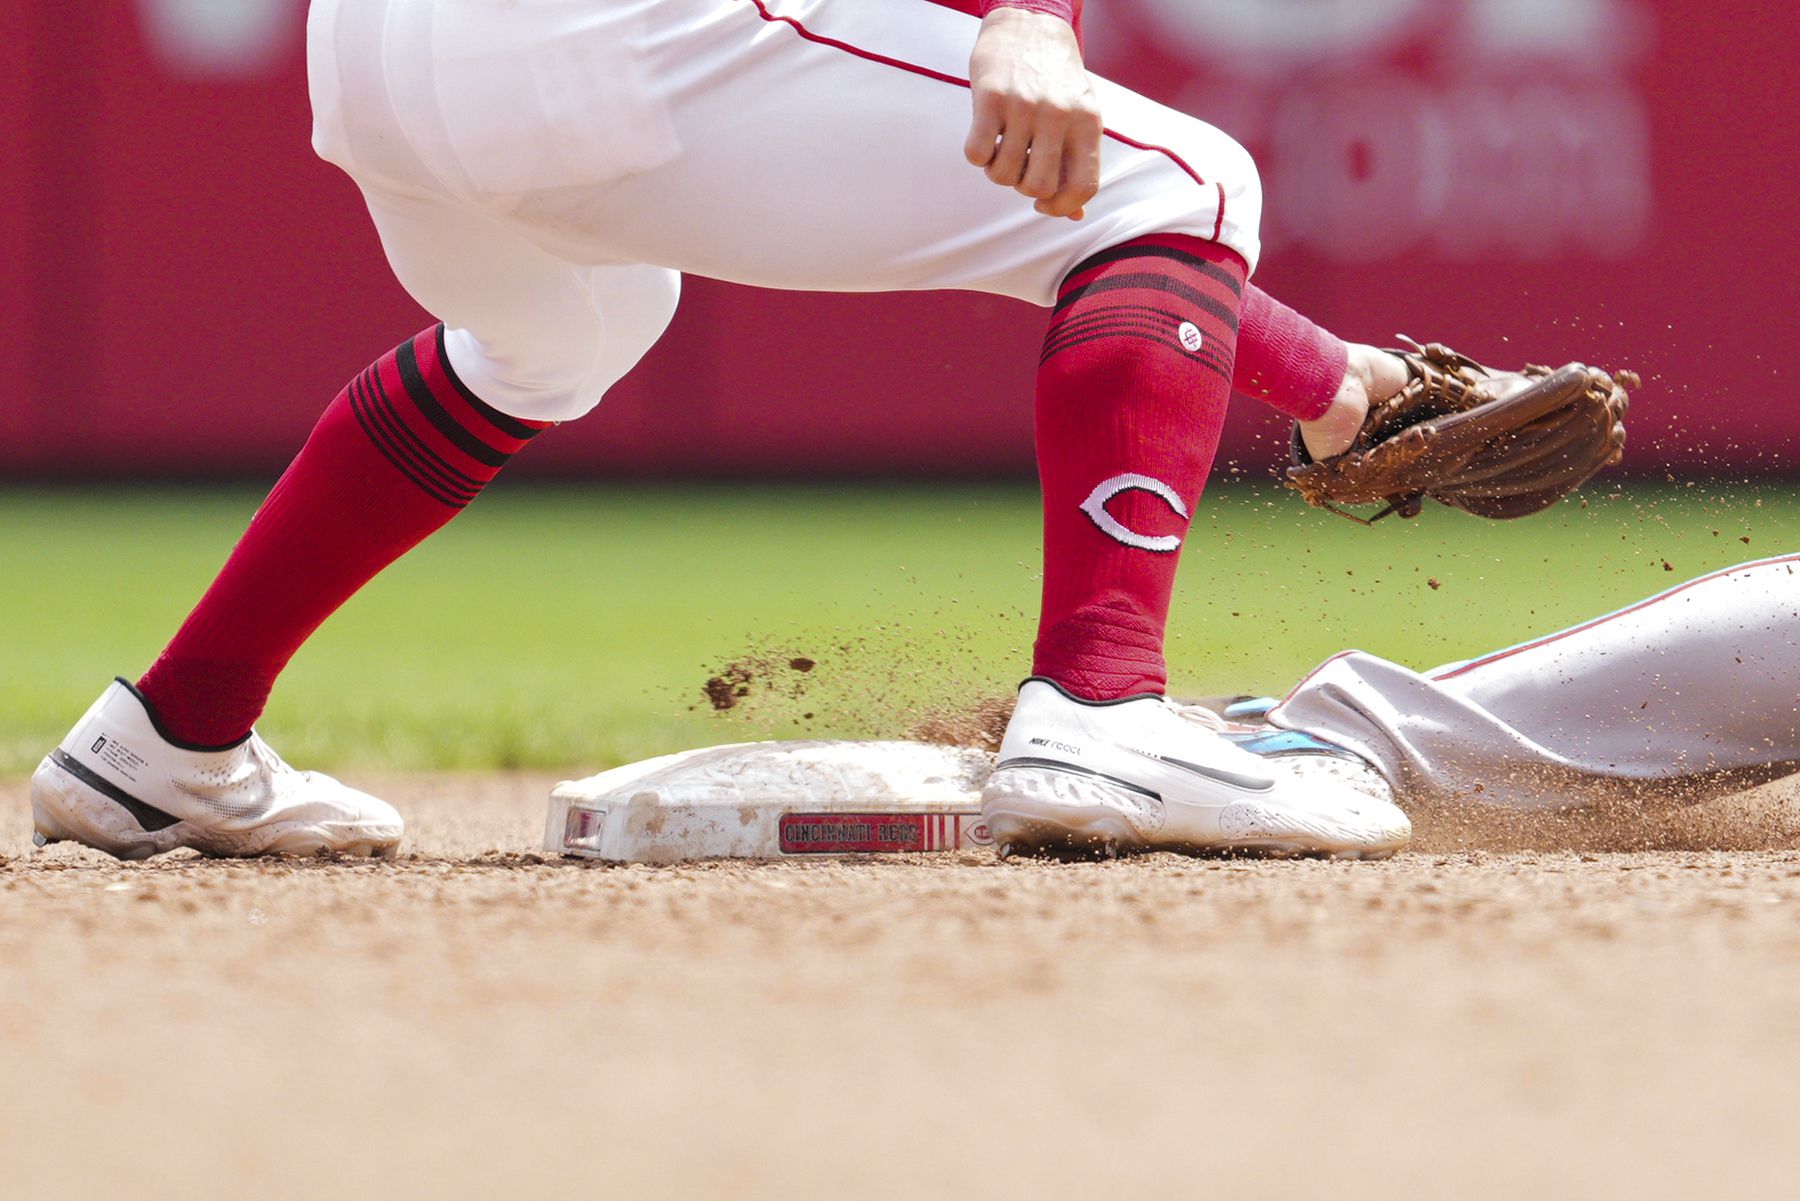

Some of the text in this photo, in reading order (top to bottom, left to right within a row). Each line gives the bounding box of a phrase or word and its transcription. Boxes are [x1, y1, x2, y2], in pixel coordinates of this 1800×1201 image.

[1028, 737, 1051, 747] NIKE
[785, 823, 918, 843] CINCINNATI REDS
